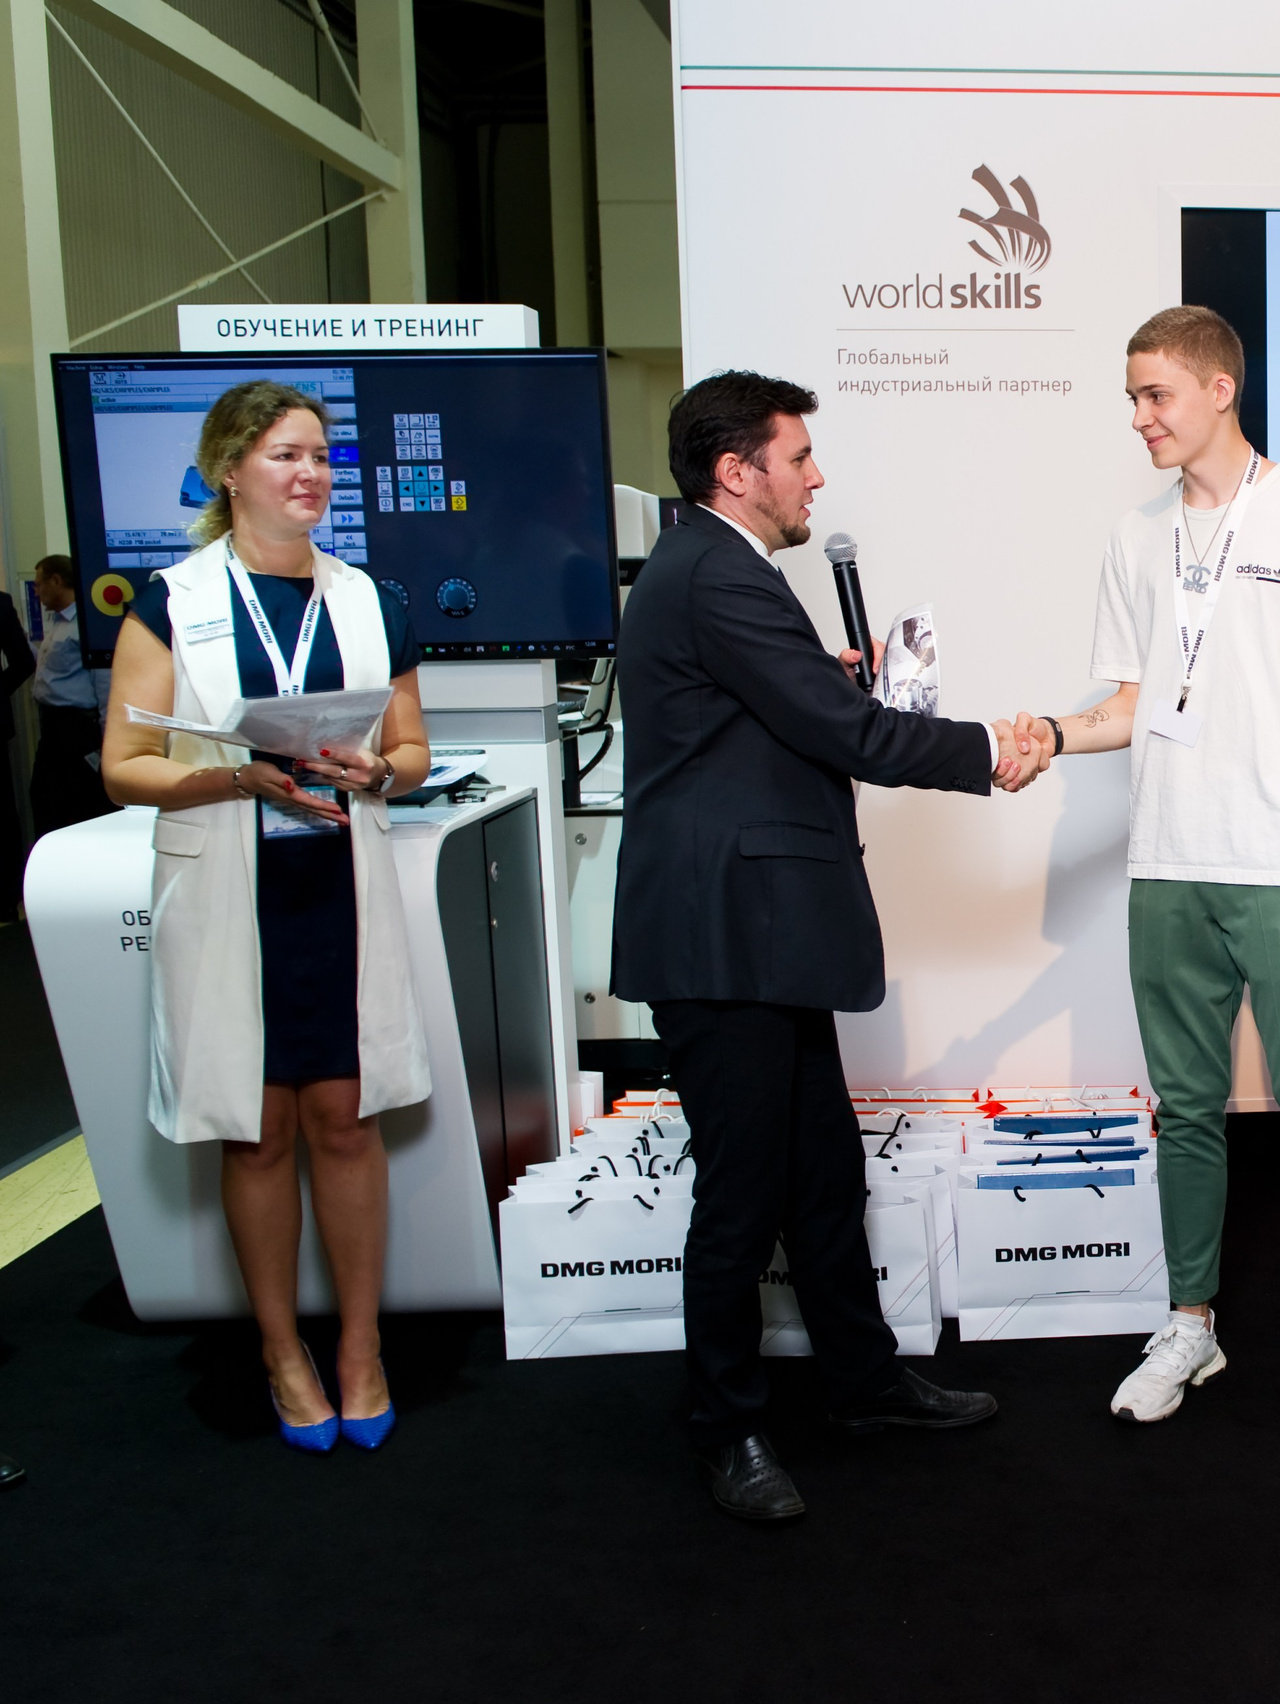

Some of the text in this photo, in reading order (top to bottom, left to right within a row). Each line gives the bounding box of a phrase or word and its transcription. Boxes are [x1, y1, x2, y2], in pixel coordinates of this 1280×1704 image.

[216, 318, 485, 338] ОБУЧЕНИЕ И ТРЕНИНГ
[837, 348, 949, 365] Глобальный
[838, 375, 1072, 397] индустриальный партнер
[1213, 530, 1235, 582] DMG MORI
[1236, 564, 1272, 576] adidas
[248, 599, 274, 644] DMG MORI
[301, 600, 318, 643] DMG MORI
[1193, 629, 1205, 653] DMG
[121, 910, 152, 926] ОБ
[120, 936, 150, 952] РЕ
[995, 1241, 1131, 1263] DMG MORI
[540, 1256, 682, 1279] DMG MORI
